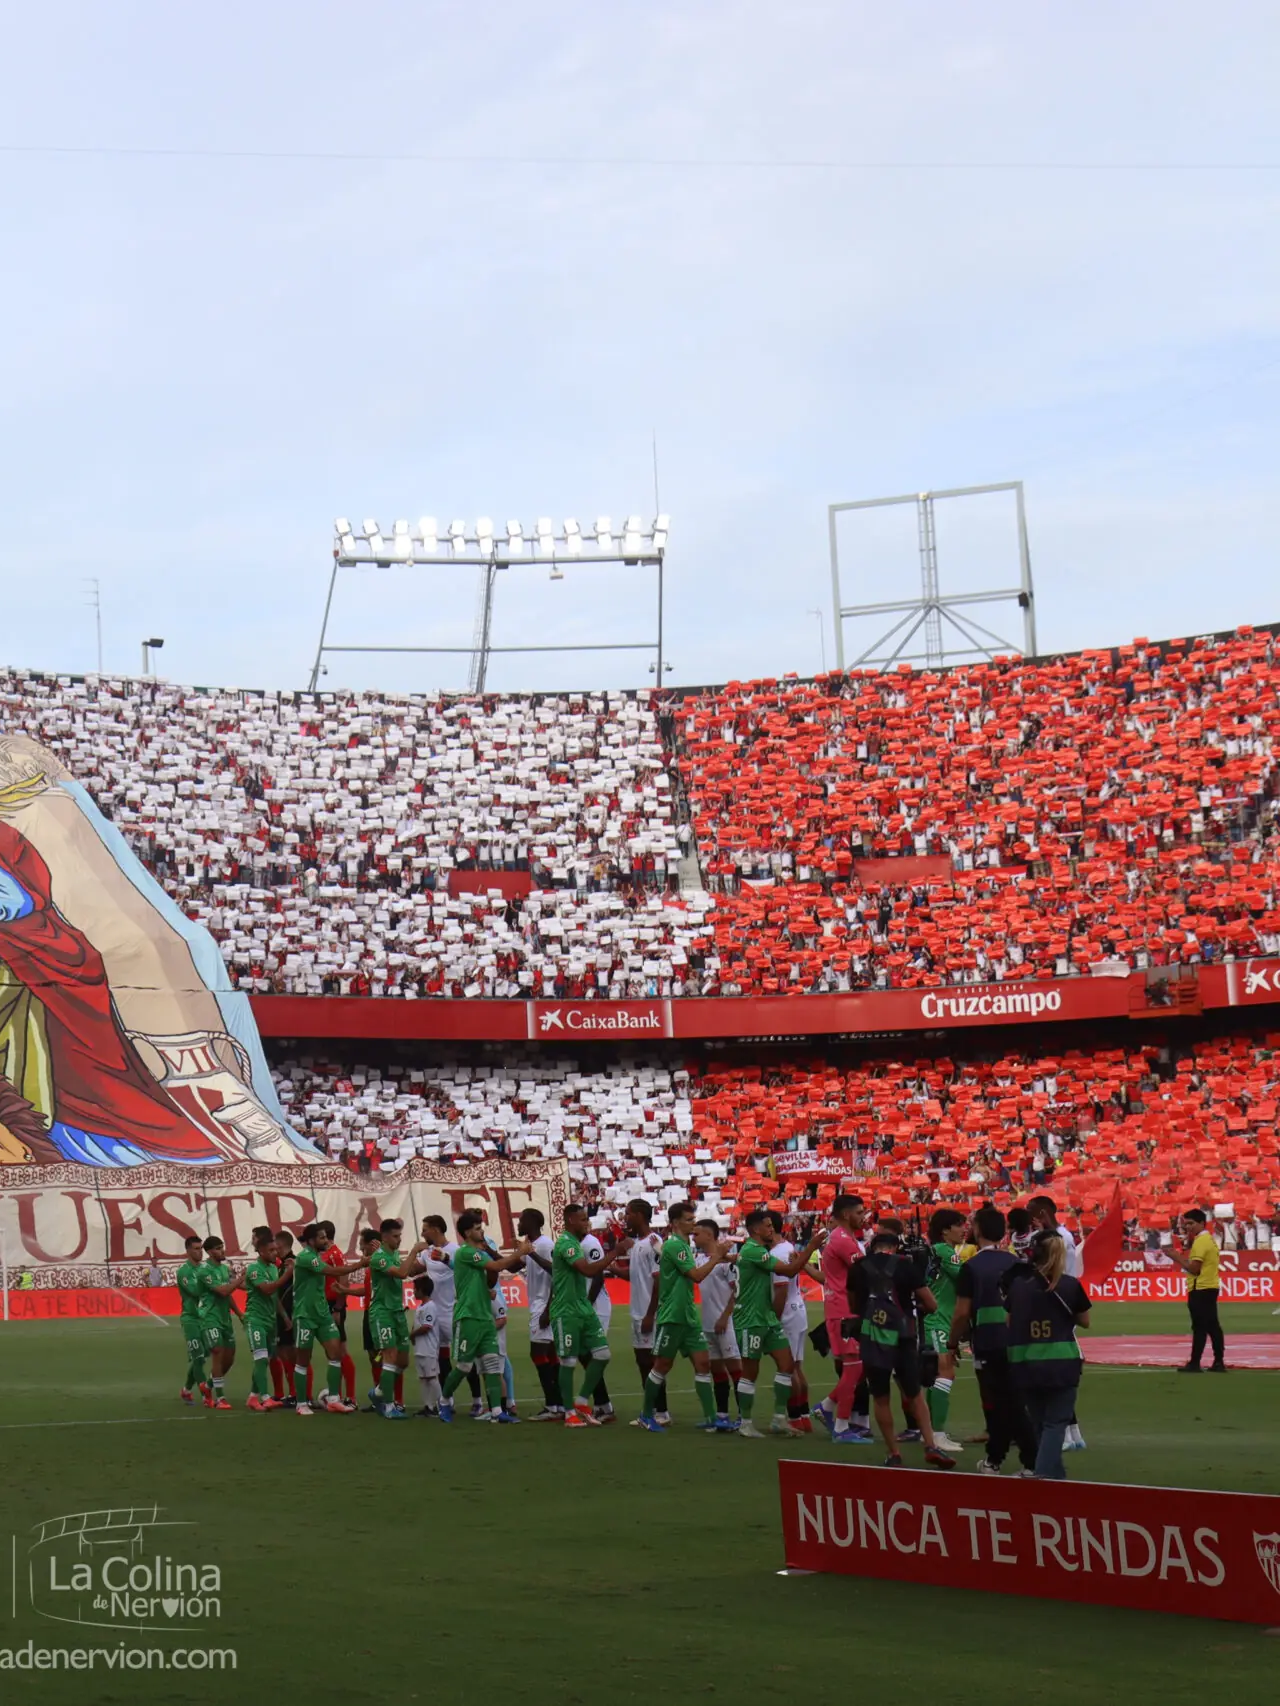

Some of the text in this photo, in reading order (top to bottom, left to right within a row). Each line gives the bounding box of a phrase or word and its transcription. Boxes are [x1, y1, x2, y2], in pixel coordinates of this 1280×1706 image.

[920, 991, 1062, 1019] Cruzcampo
[566, 1010, 661, 1030] CaixaBank
[1089, 1277, 1274, 1297] NEVER SUNDER
[43, 1293, 68, 1315] TE
[207, 1327, 219, 1339] 10
[253, 1330, 261, 1342] 8
[299, 1328, 310, 1340] 12
[380, 1327, 393, 1340] 21
[1030, 1320, 1052, 1338] 65
[459, 1339, 467, 1352] 4
[564, 1333, 572, 1347] 6
[661, 1334, 670, 1347] 3
[749, 1334, 761, 1349] 18
[795, 1492, 1226, 1587] NUNCA TE RINDAS
